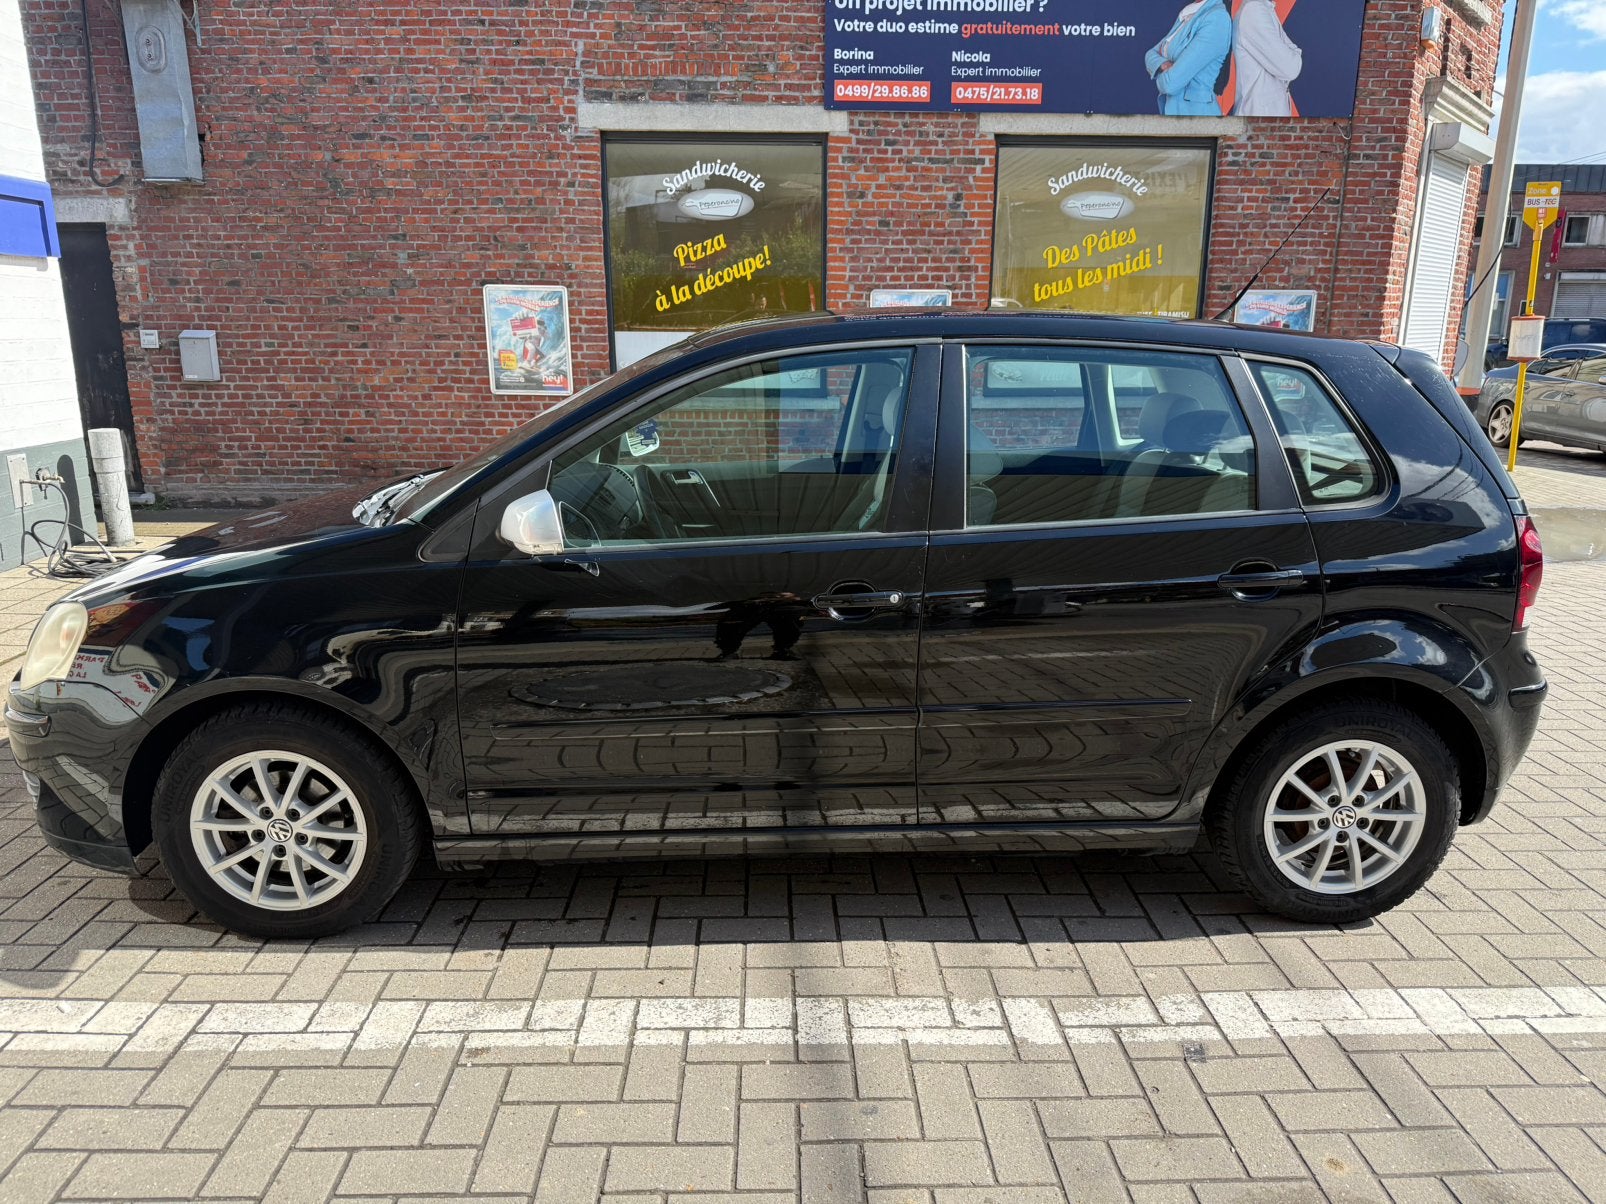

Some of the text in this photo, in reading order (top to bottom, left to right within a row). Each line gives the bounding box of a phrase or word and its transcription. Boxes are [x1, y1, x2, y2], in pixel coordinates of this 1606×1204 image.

[835, 0, 1048, 15] Un projet immobilier ?
[834, 19, 1136, 38] Votre duo estime gratuitement votre bien
[834, 48, 874, 60] Borina
[952, 50, 990, 63] Nicola
[834, 63, 924, 76] Expert immobilier
[951, 65, 1041, 78] Expert immobilier
[836, 83, 928, 99] 0499/29.86.86
[955, 84, 1039, 101] 0475/21.73.18
[662, 159, 766, 195] Sandwicherie
[1048, 162, 1148, 196] Sandwicherie
[1527, 198, 1541, 206] BUS
[673, 233, 727, 267] Pizza
[1043, 227, 1137, 269] Des Pâtes
[655, 245, 772, 312] à la découpe!
[1034, 244, 1163, 302] tous les midi !
[542, 373, 563, 384] hey!
